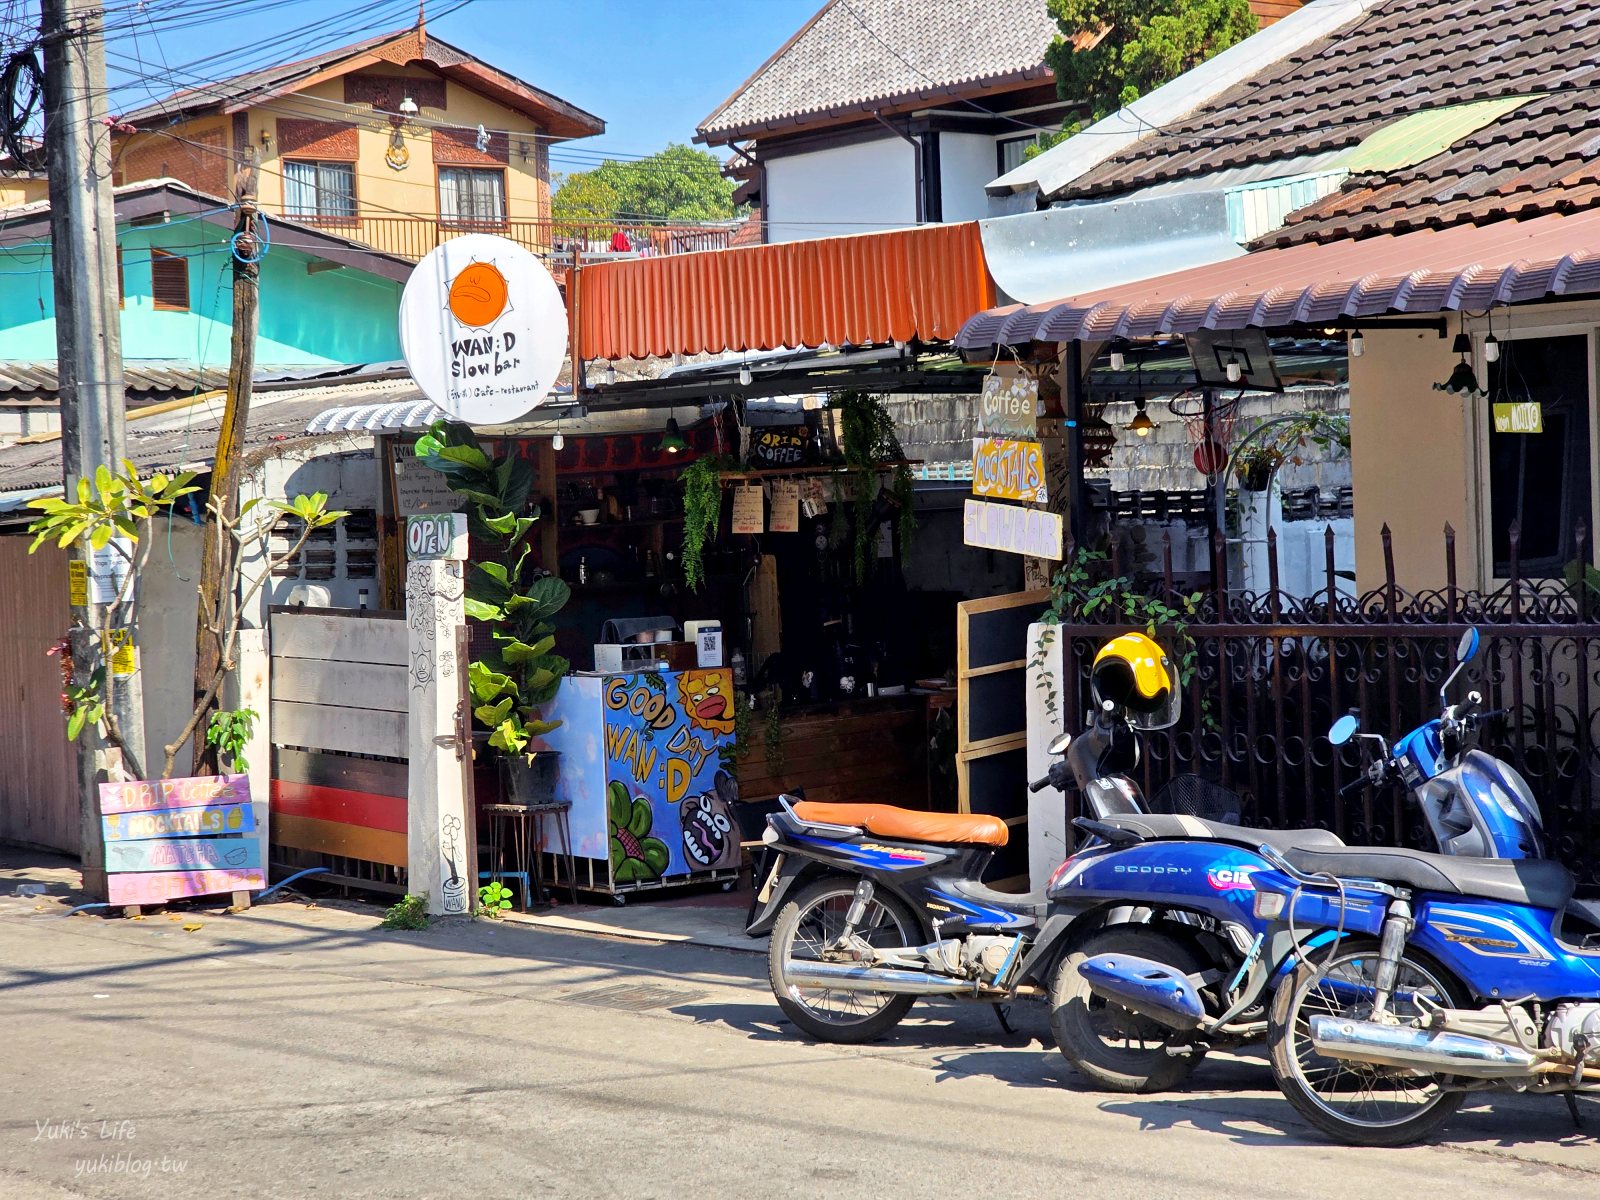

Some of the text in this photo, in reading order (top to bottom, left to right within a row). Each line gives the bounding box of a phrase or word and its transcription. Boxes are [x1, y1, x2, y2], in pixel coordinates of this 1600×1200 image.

[451, 332, 516, 359] WAN:D
[451, 351, 521, 378] Slow bar
[984, 390, 1031, 417] Coffee
[757, 444, 802, 463] COFFEE
[975, 445, 1040, 493] MOCKTAILS
[409, 520, 450, 554] OPEN
[606, 678, 718, 777] GOOD DAY
[123, 782, 175, 809] DRIP
[127, 810, 224, 837] MOCKTAILS
[152, 844, 220, 866] MATCHA
[1114, 865, 1192, 876] SCOOPY
[926, 902, 951, 912] HONDA
